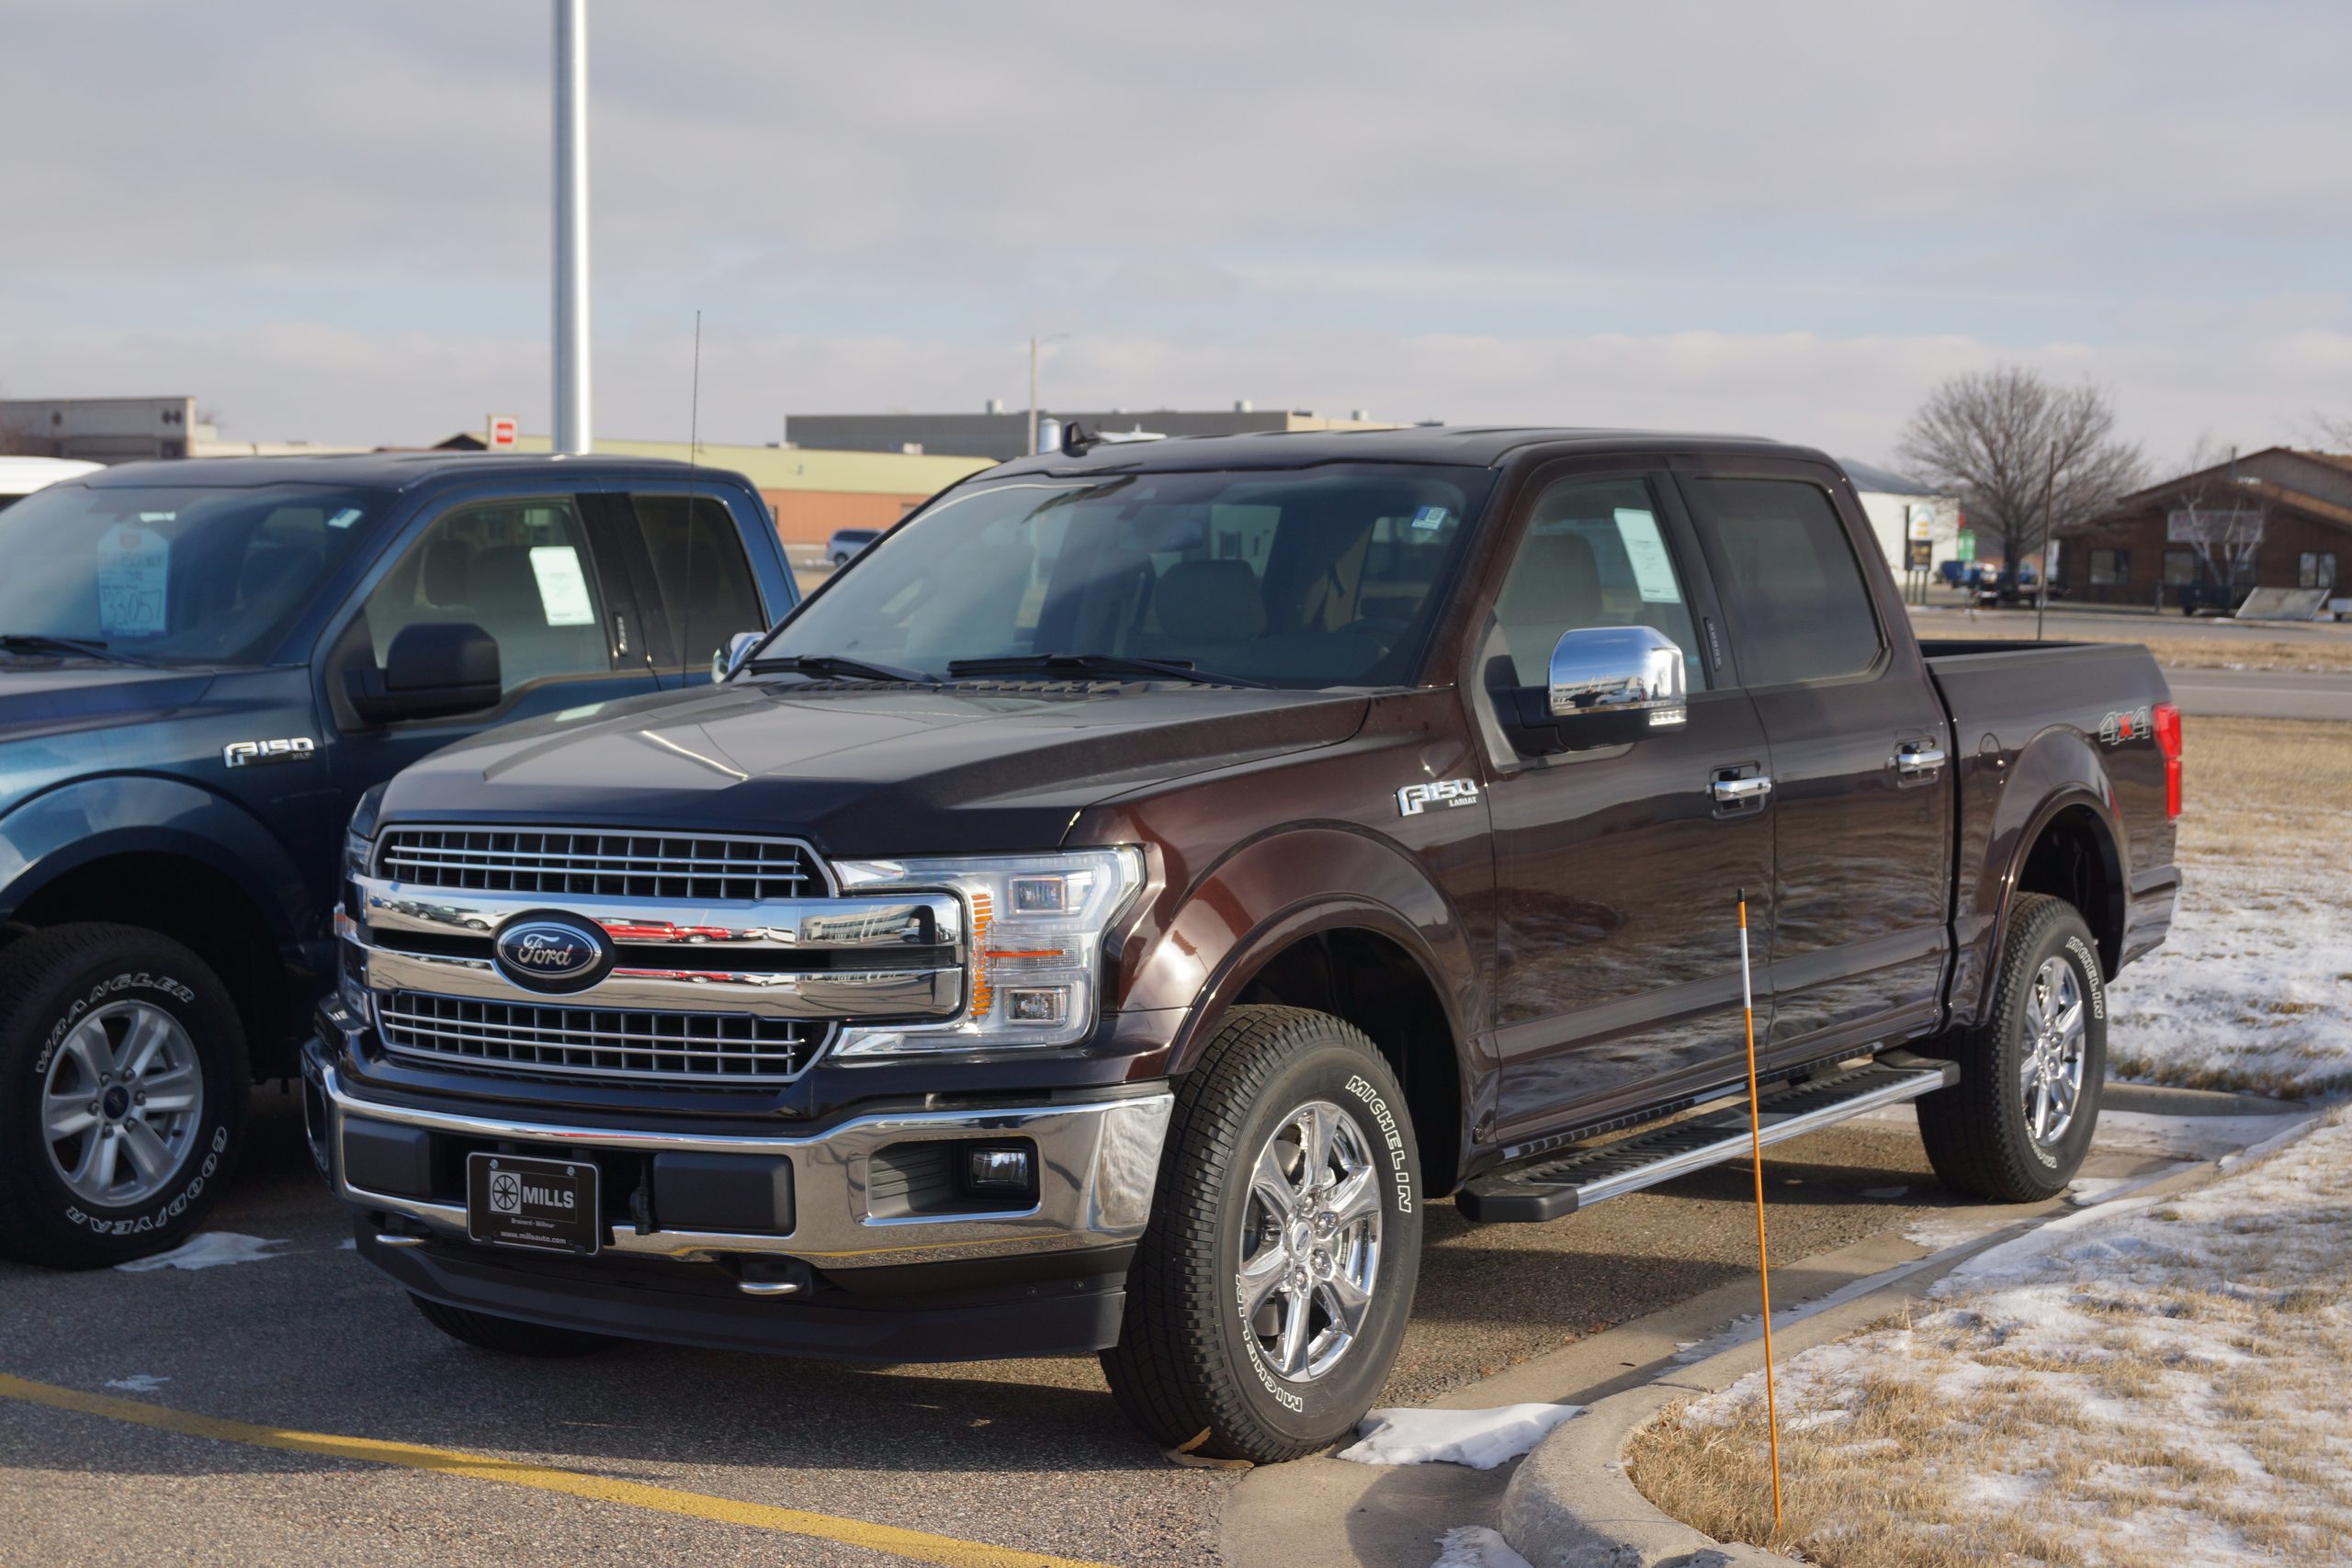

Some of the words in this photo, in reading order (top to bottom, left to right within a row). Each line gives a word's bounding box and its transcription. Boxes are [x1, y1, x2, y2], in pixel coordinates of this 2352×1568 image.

[1449, 796, 1477, 807] LARIAT
[518, 933, 572, 965] Ford
[2066, 936, 2103, 1020] MICHELIN
[36, 972, 195, 1073] WRANGLER
[66, 1125, 228, 1235] GOODYEAR
[1345, 1075, 1412, 1213] MICHELIN
[501, 1230, 567, 1245] www.millsauto.com
[522, 1186, 574, 1209] MILLS
[1236, 1273, 1303, 1413] MICHELIN
